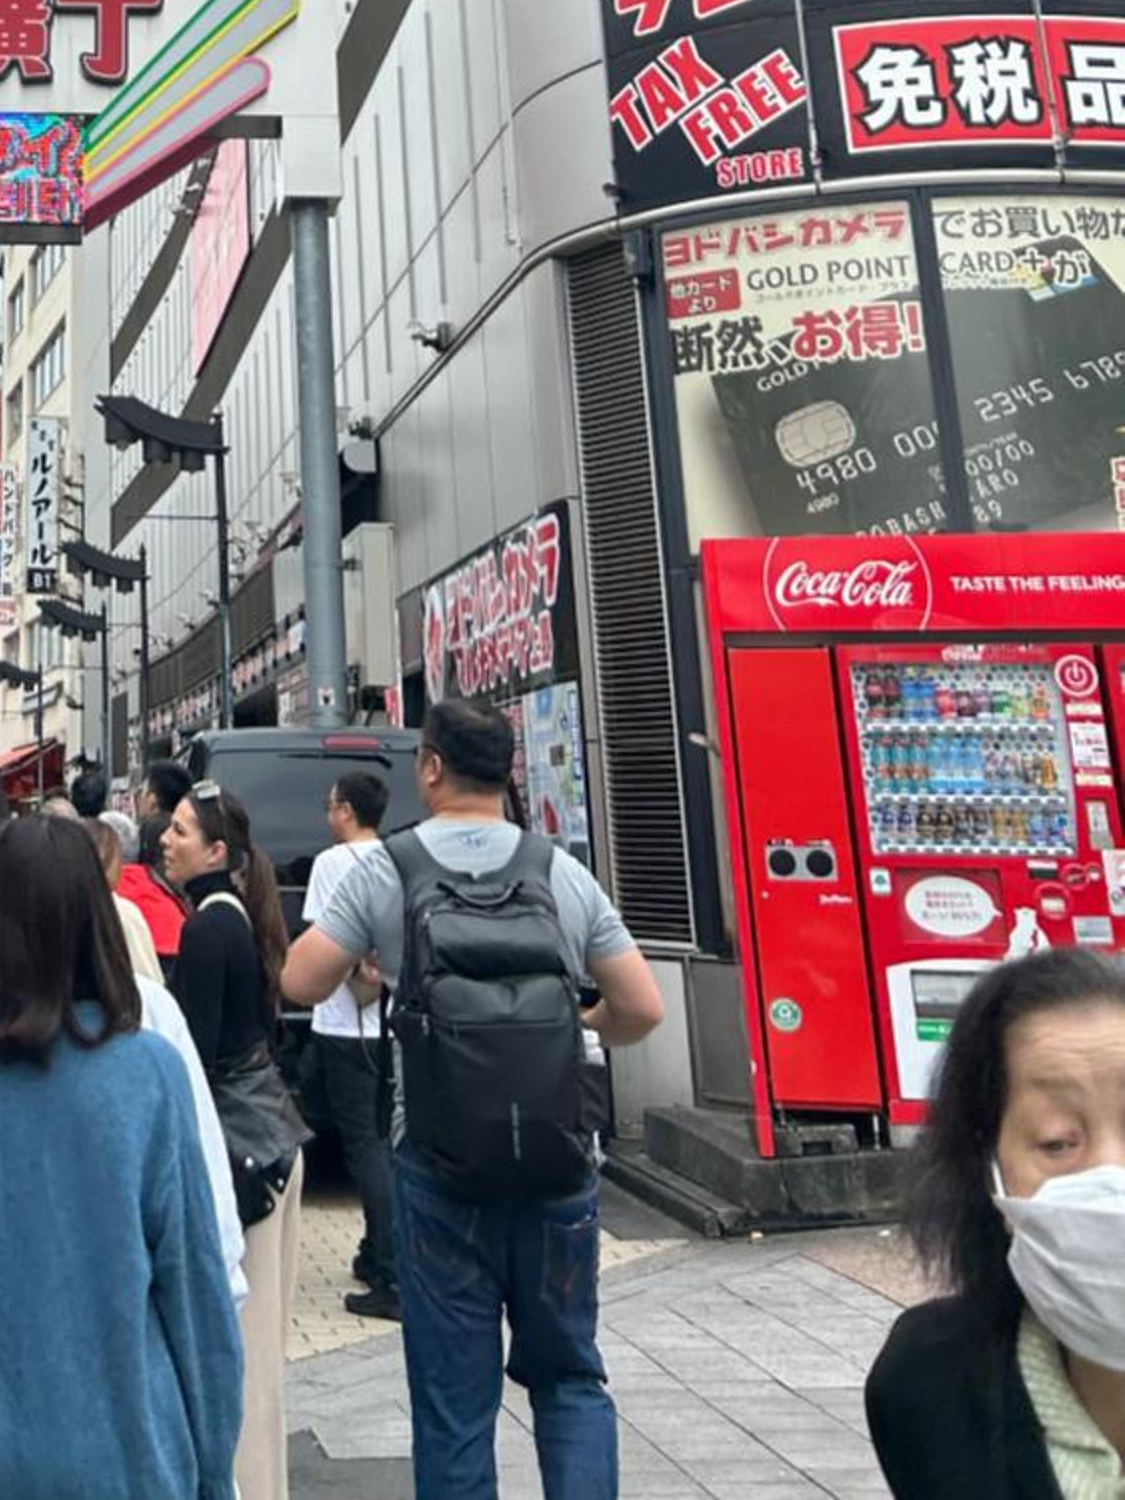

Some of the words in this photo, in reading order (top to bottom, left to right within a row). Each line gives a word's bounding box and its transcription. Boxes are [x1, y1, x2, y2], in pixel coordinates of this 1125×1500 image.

[609, 36, 726, 152] TAX
[679, 47, 809, 167] FREE
[852, 34, 1125, 136] 免税品
[715, 148, 805, 188] STORE
[663, 210, 906, 267] ヨドバシカメラ
[746, 263, 818, 292] GOLD
[827, 254, 910, 282] POINT
[939, 251, 1014, 275] CARD
[756, 361, 809, 392] GOLD
[975, 378, 1054, 423] 2345
[796, 448, 876, 495] 4980
[31, 453, 53, 566] ルノアール
[775, 560, 919, 607] Coca-Cola
[949, 576, 1003, 592] TASTE
[1008, 576, 1044, 591] THE
